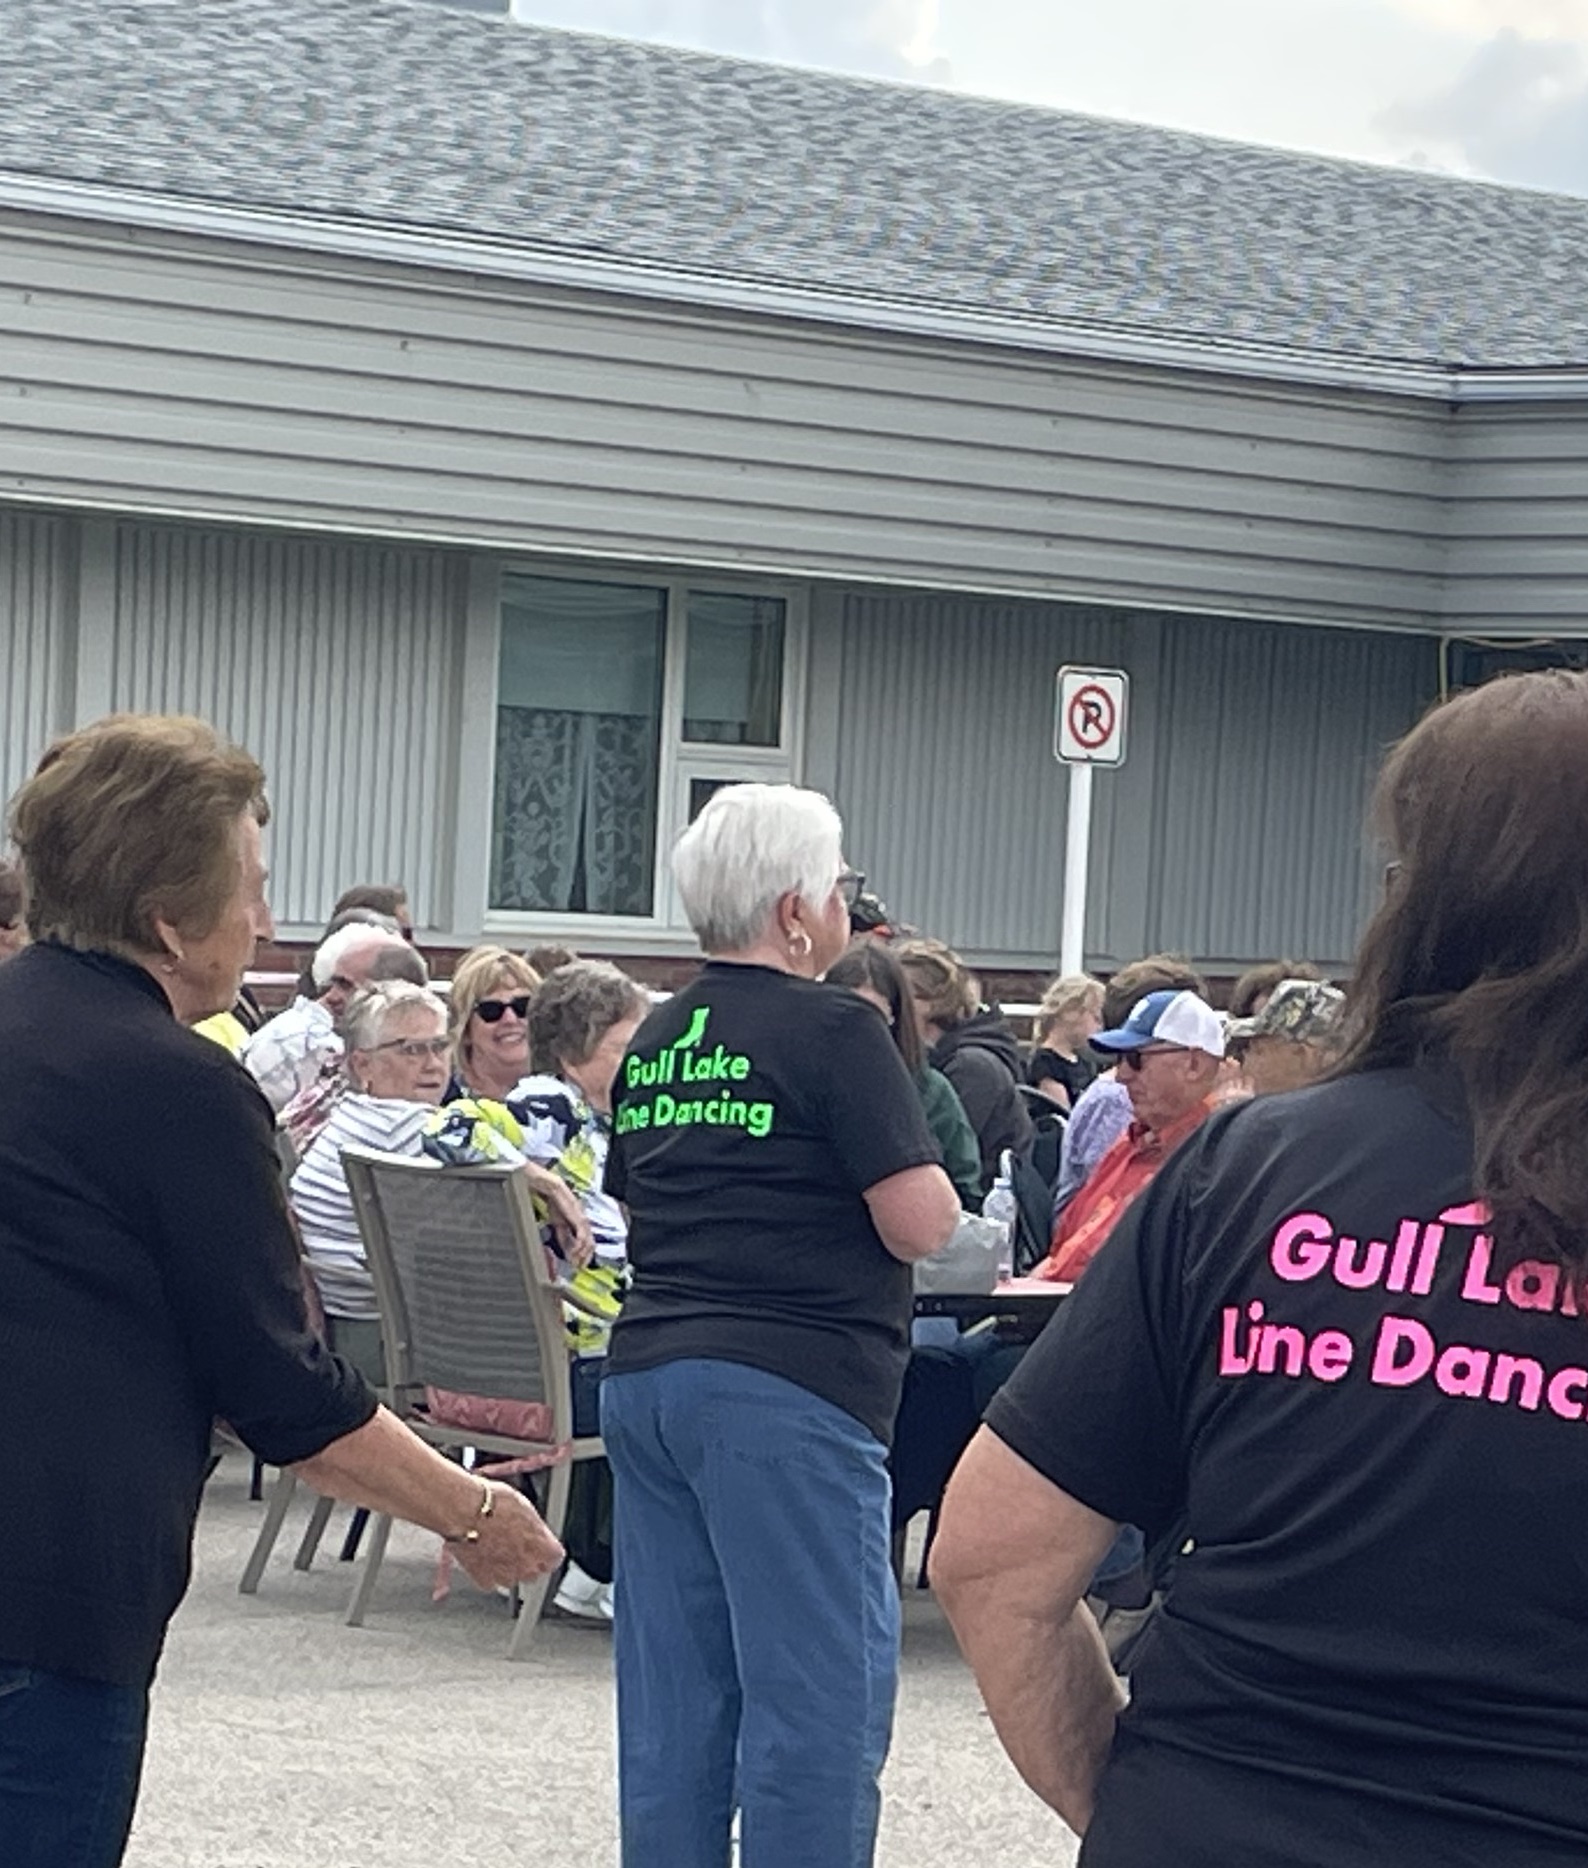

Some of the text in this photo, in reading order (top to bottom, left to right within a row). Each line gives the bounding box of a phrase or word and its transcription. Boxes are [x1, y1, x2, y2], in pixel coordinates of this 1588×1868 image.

[627, 1045, 750, 1088] Gull Lake
[653, 1089, 774, 1137] Dancing
[1269, 1212, 1445, 1295] Gull
[1218, 1299, 1354, 1382] Line
